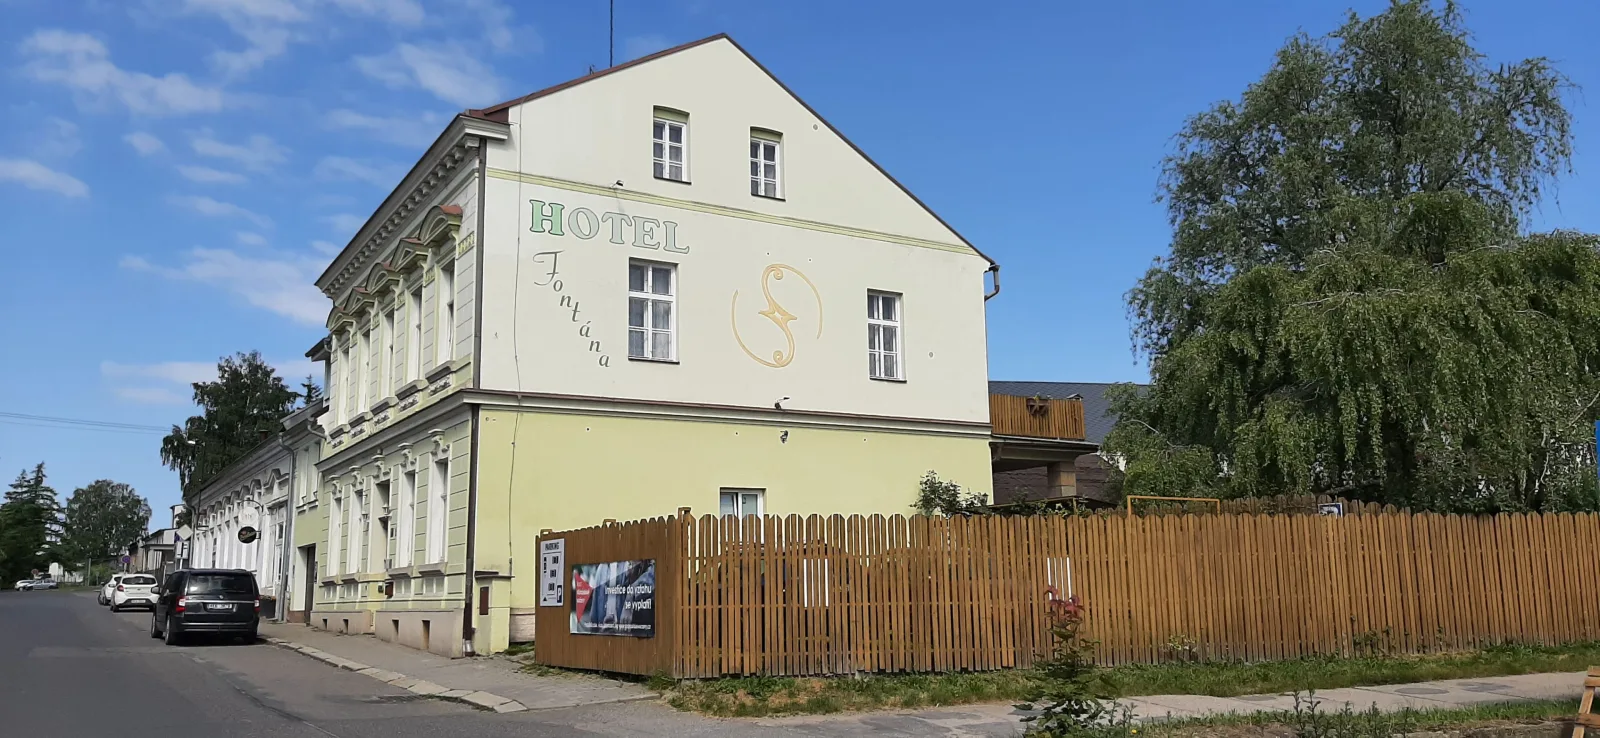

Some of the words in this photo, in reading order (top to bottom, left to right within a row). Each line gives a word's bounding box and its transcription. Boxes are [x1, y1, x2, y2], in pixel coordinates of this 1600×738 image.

[529, 199, 690, 254] HOTEL
[532, 250, 610, 368] Fontána
[625, 601, 632, 609] se
[627, 584, 634, 594] do
